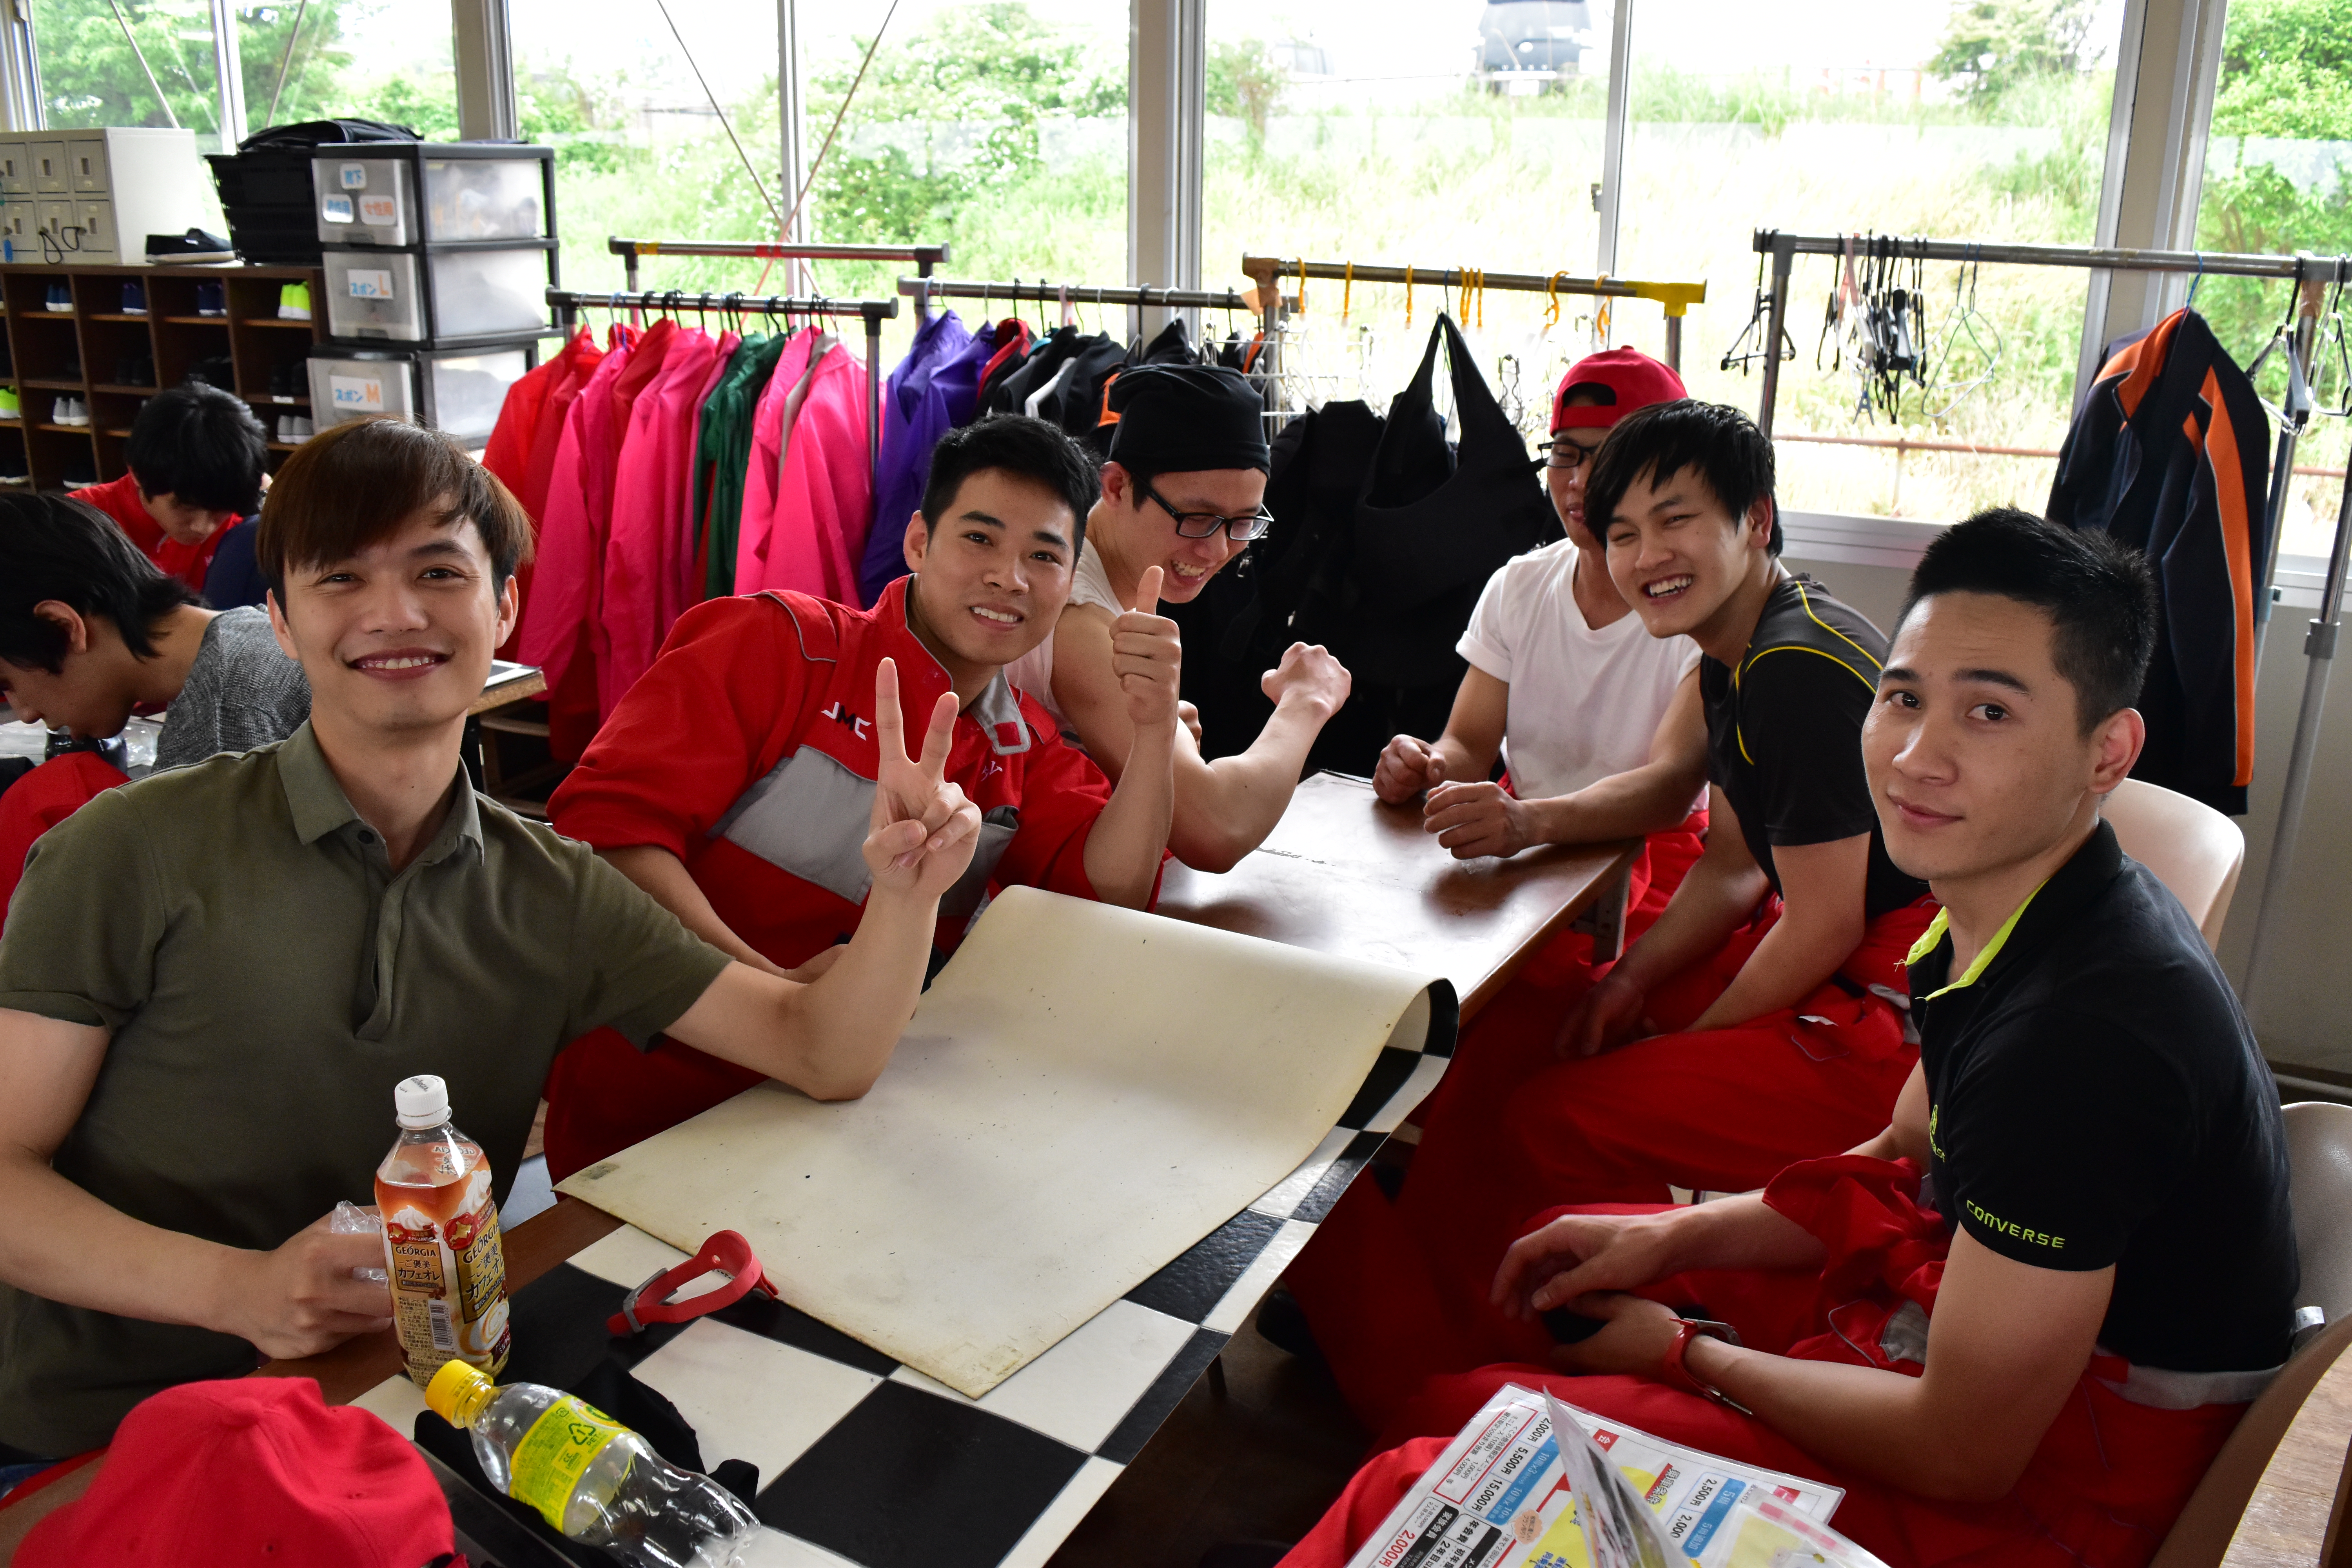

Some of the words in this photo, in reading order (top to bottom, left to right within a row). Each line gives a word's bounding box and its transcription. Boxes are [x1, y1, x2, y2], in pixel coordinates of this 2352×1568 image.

[378, 274, 389, 295] L
[366, 383, 380, 403] M
[821, 701, 871, 741] JMC
[1967, 1200, 2065, 1249] CONVERSE
[396, 1244, 436, 1257] GEORGIA
[398, 1267, 441, 1281] カフェオレ
[405, 1259, 431, 1270] ご褒美
[587, 1434, 598, 1446] PET
[1525, 1416, 1554, 1443] 2,000円
[1452, 1456, 1472, 1476] 4,000円
[1459, 1460, 1479, 1479] 1,000円
[1498, 1446, 1530, 1475] 5,500円
[1468, 1477, 1505, 1512] 15,000円
[1689, 1477, 1717, 1507] 2,500円
[1425, 1510, 1453, 1539] 家族会員
[1456, 1519, 1480, 1544] 年会費
[1375, 1528, 1417, 1568] 2,000円
